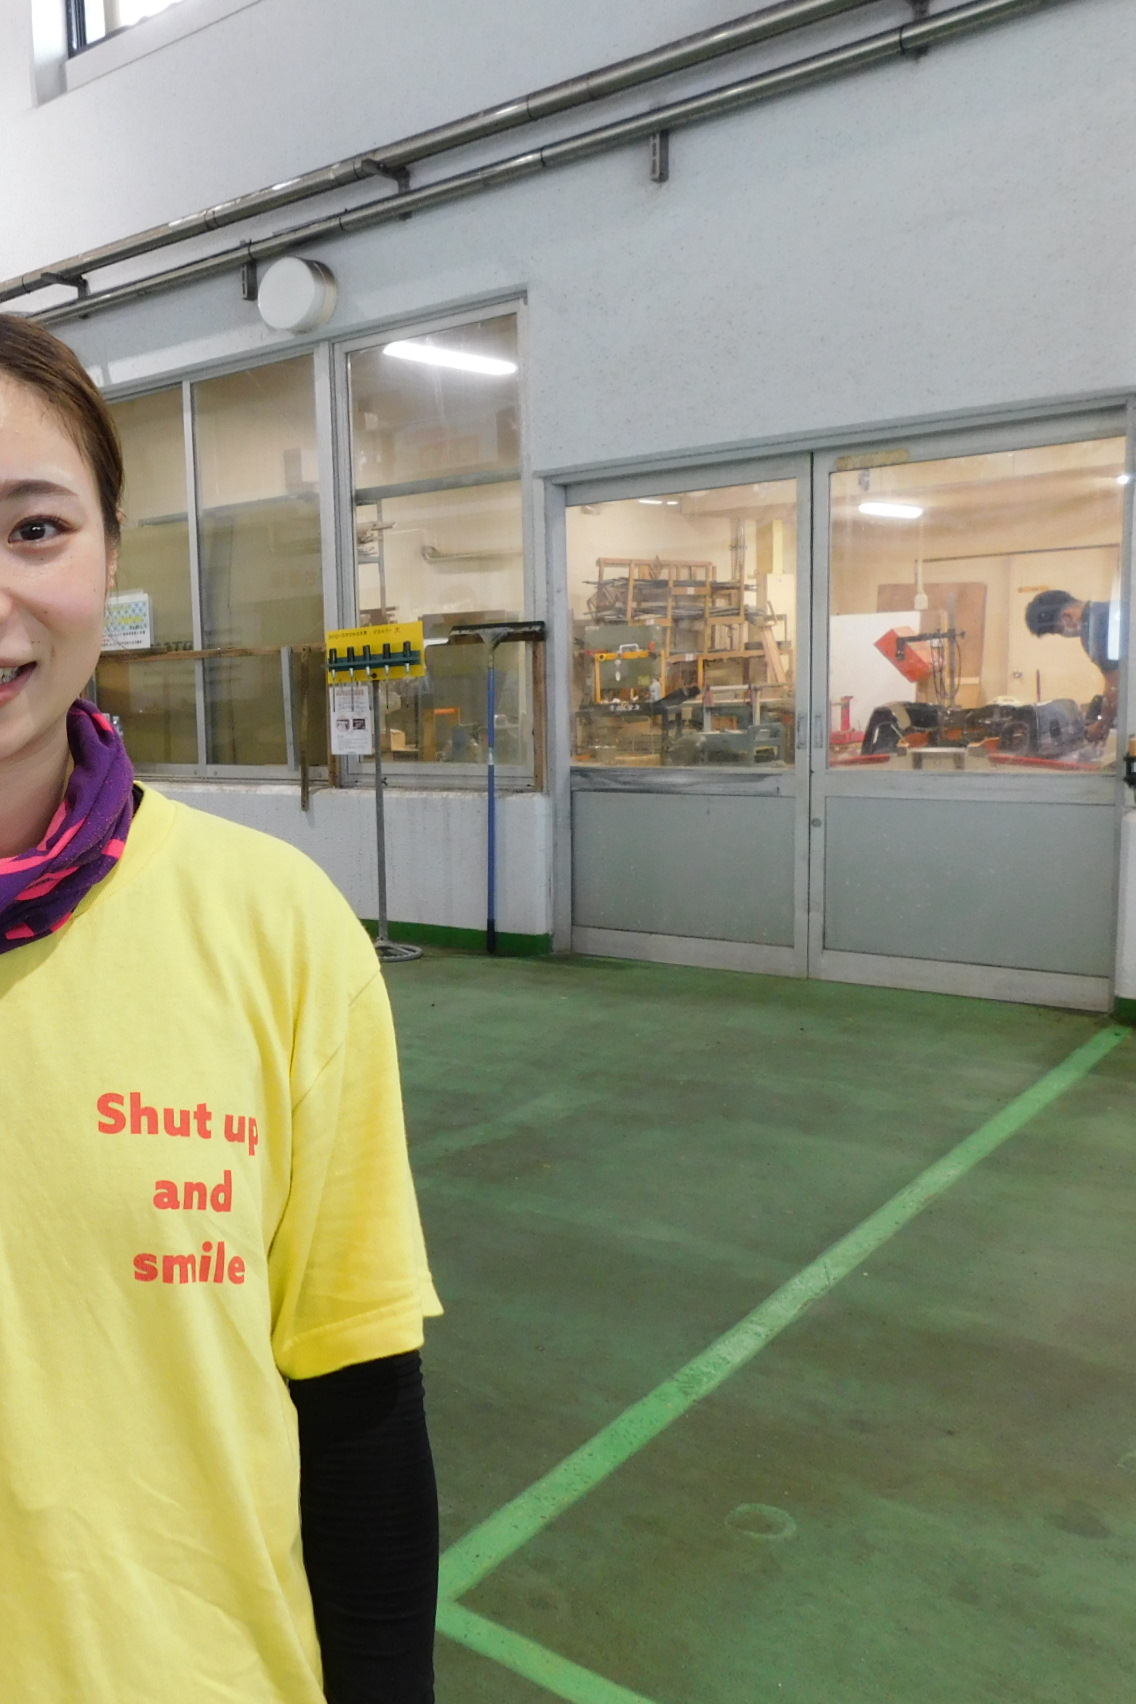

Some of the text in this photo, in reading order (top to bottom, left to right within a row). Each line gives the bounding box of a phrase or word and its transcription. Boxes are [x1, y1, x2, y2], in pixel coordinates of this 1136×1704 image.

[97, 1092, 259, 1156] Shut up
[153, 1169, 233, 1213] and
[133, 1241, 246, 1285] smile
